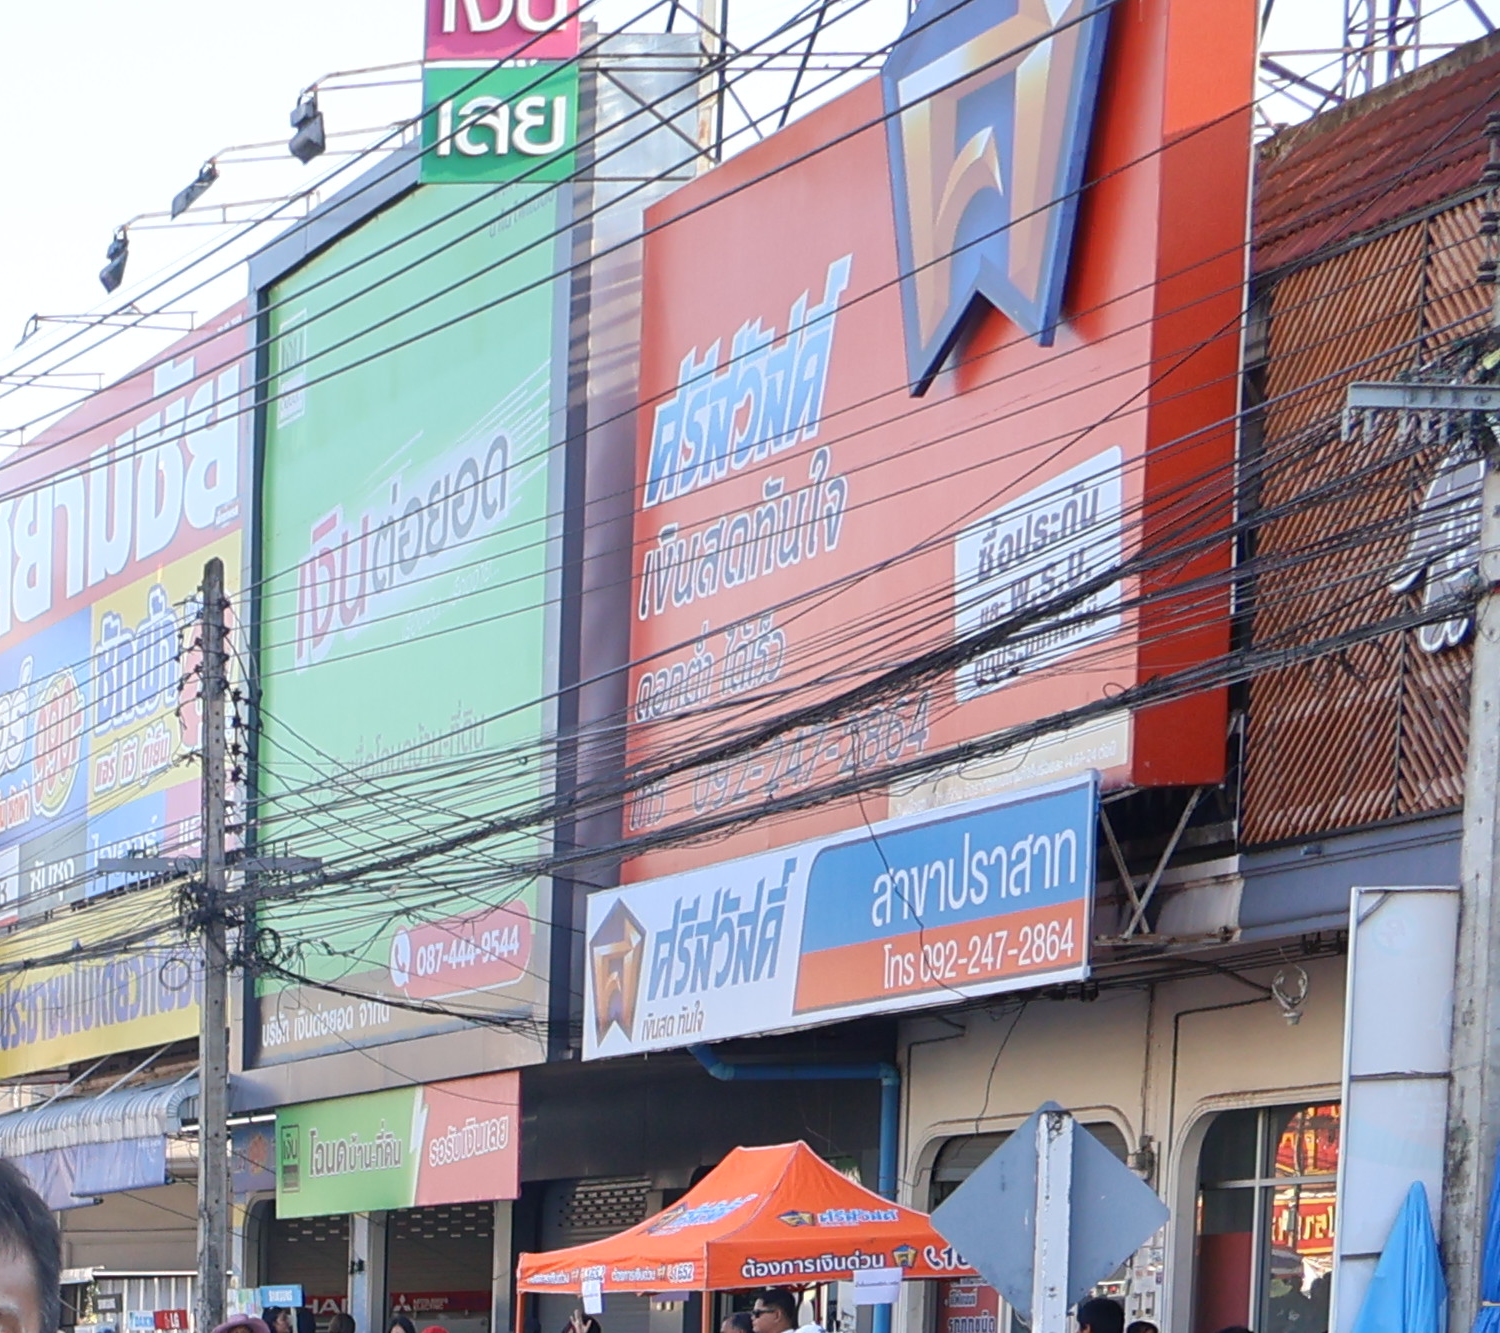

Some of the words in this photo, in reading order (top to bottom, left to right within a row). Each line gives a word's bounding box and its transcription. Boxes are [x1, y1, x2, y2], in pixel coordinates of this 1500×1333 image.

[437, 95, 567, 156] เลย
[297, 435, 508, 659] เงินต่อยอด
[639, 446, 848, 620] เงินสดทันใจ
[872, 829, 1076, 927] สาขาปราสาท
[416, 925, 520, 977] 087-444-9544
[647, 858, 798, 1001] ศรีสวัสดิ์
[884, 943, 915, 990] โทร
[920, 918, 1074, 984] 092-247-2864
[262, 1010, 290, 1048] บริษัท
[294, 998, 353, 1042] เงินต่อยอด
[642, 1011, 674, 1042] เงินสด
[677, 1001, 704, 1032] ทันใจ
[741, 1250, 885, 1278] ต้องการเงินด่วน
[943, 1247, 975, 1271] 16
[170, 1313, 180, 1328] LG
